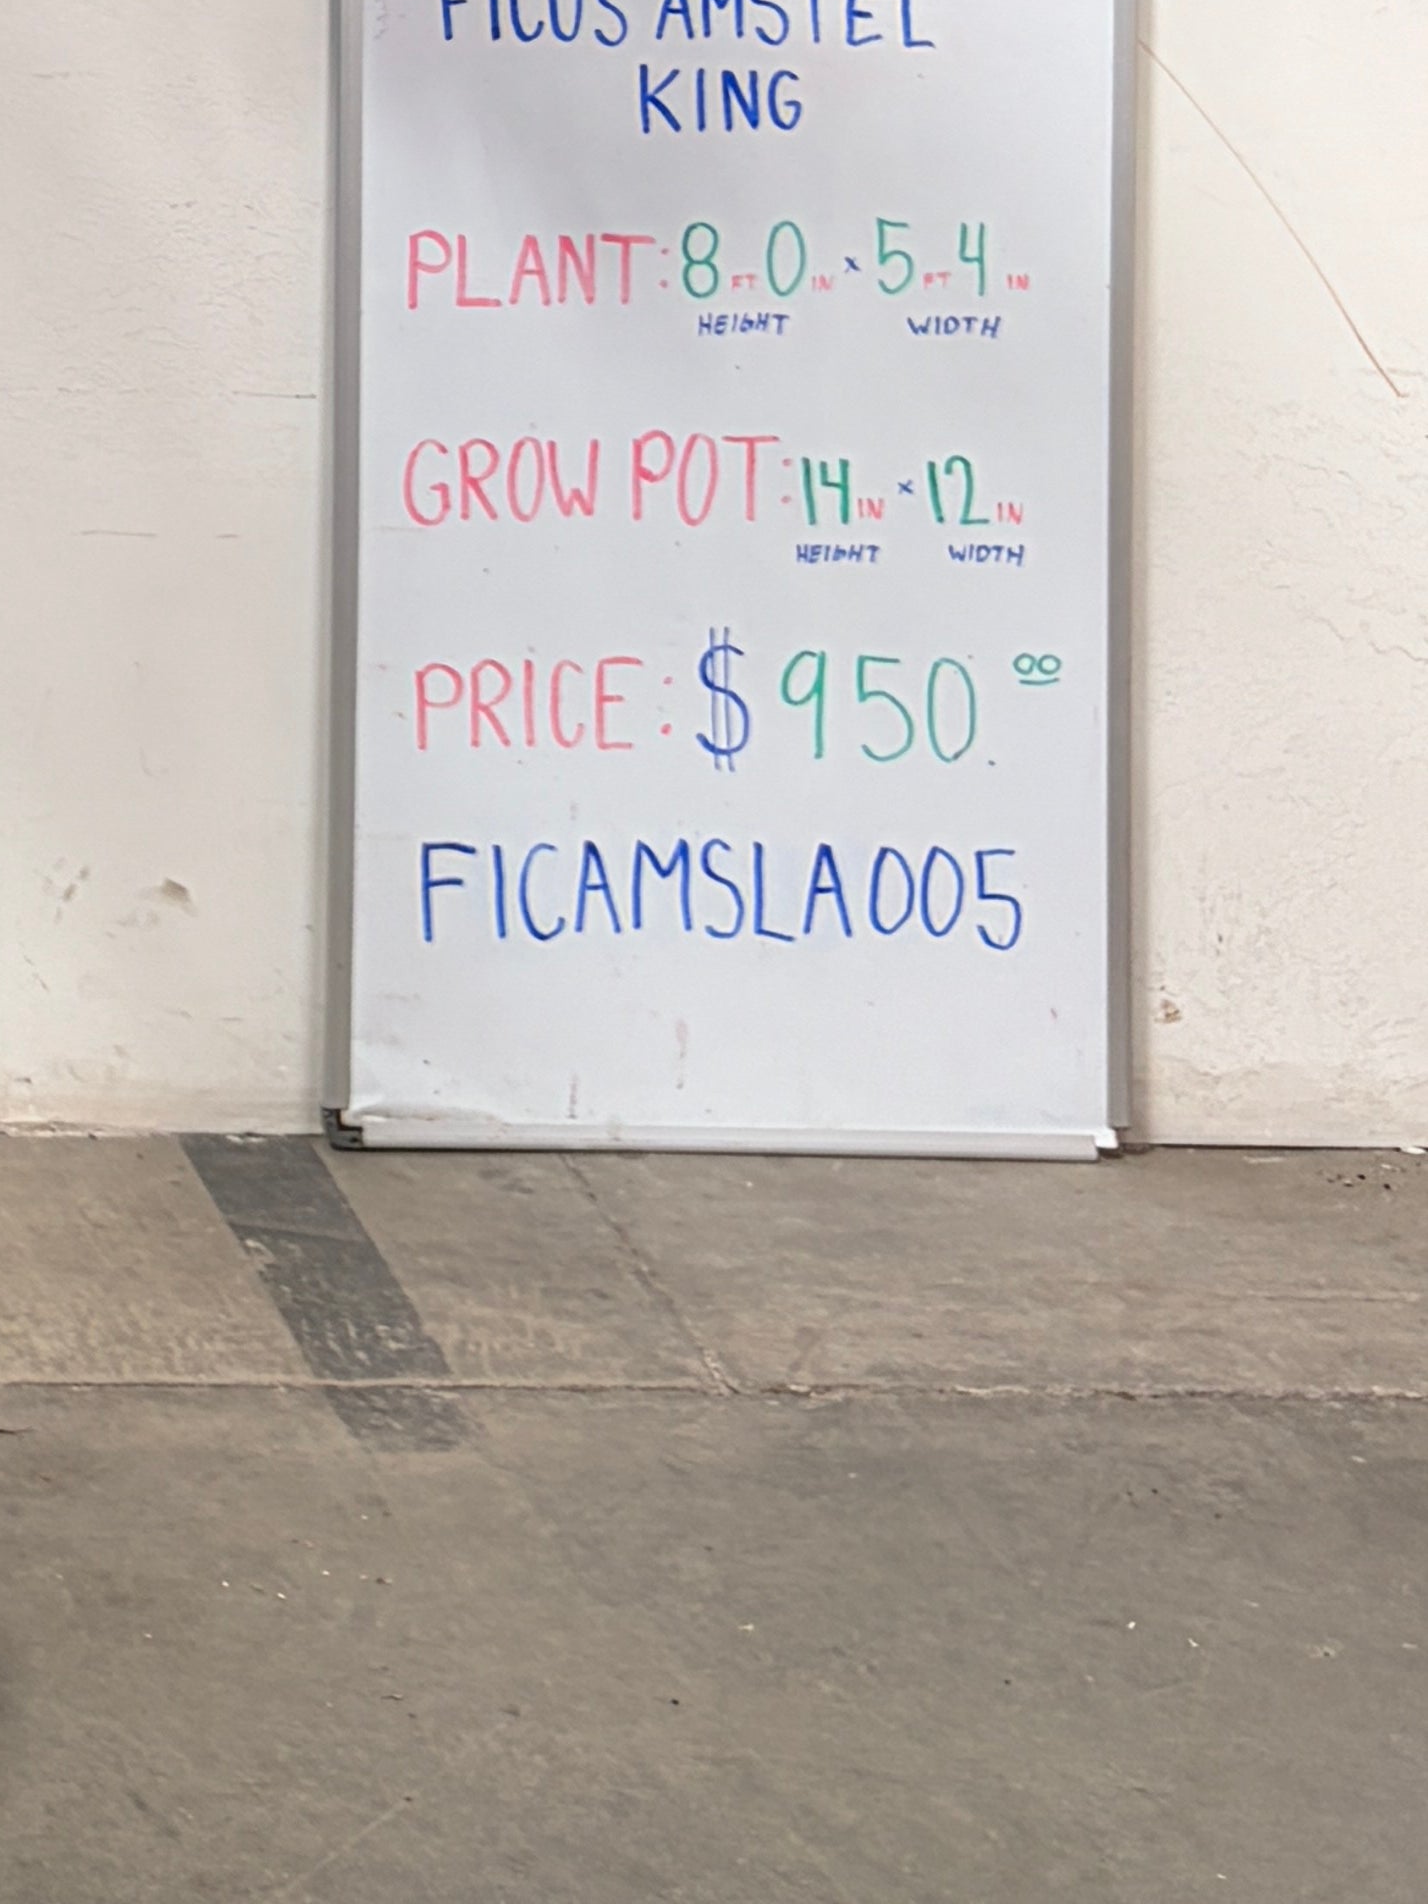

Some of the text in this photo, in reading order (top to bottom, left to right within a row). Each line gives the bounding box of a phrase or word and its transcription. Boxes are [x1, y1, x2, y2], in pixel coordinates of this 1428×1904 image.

[638, 64, 802, 134] KING
[407, 230, 670, 310] PLANT:
[697, 312, 1002, 339] HEIGHT WIDTH
[404, 437, 600, 527] GROW
[631, 430, 793, 527] POT:
[795, 543, 1026, 568] HEIGHT WIDTH
[414, 656, 674, 750] PRICE:
[421, 838, 1022, 952] FICAMSLA005
